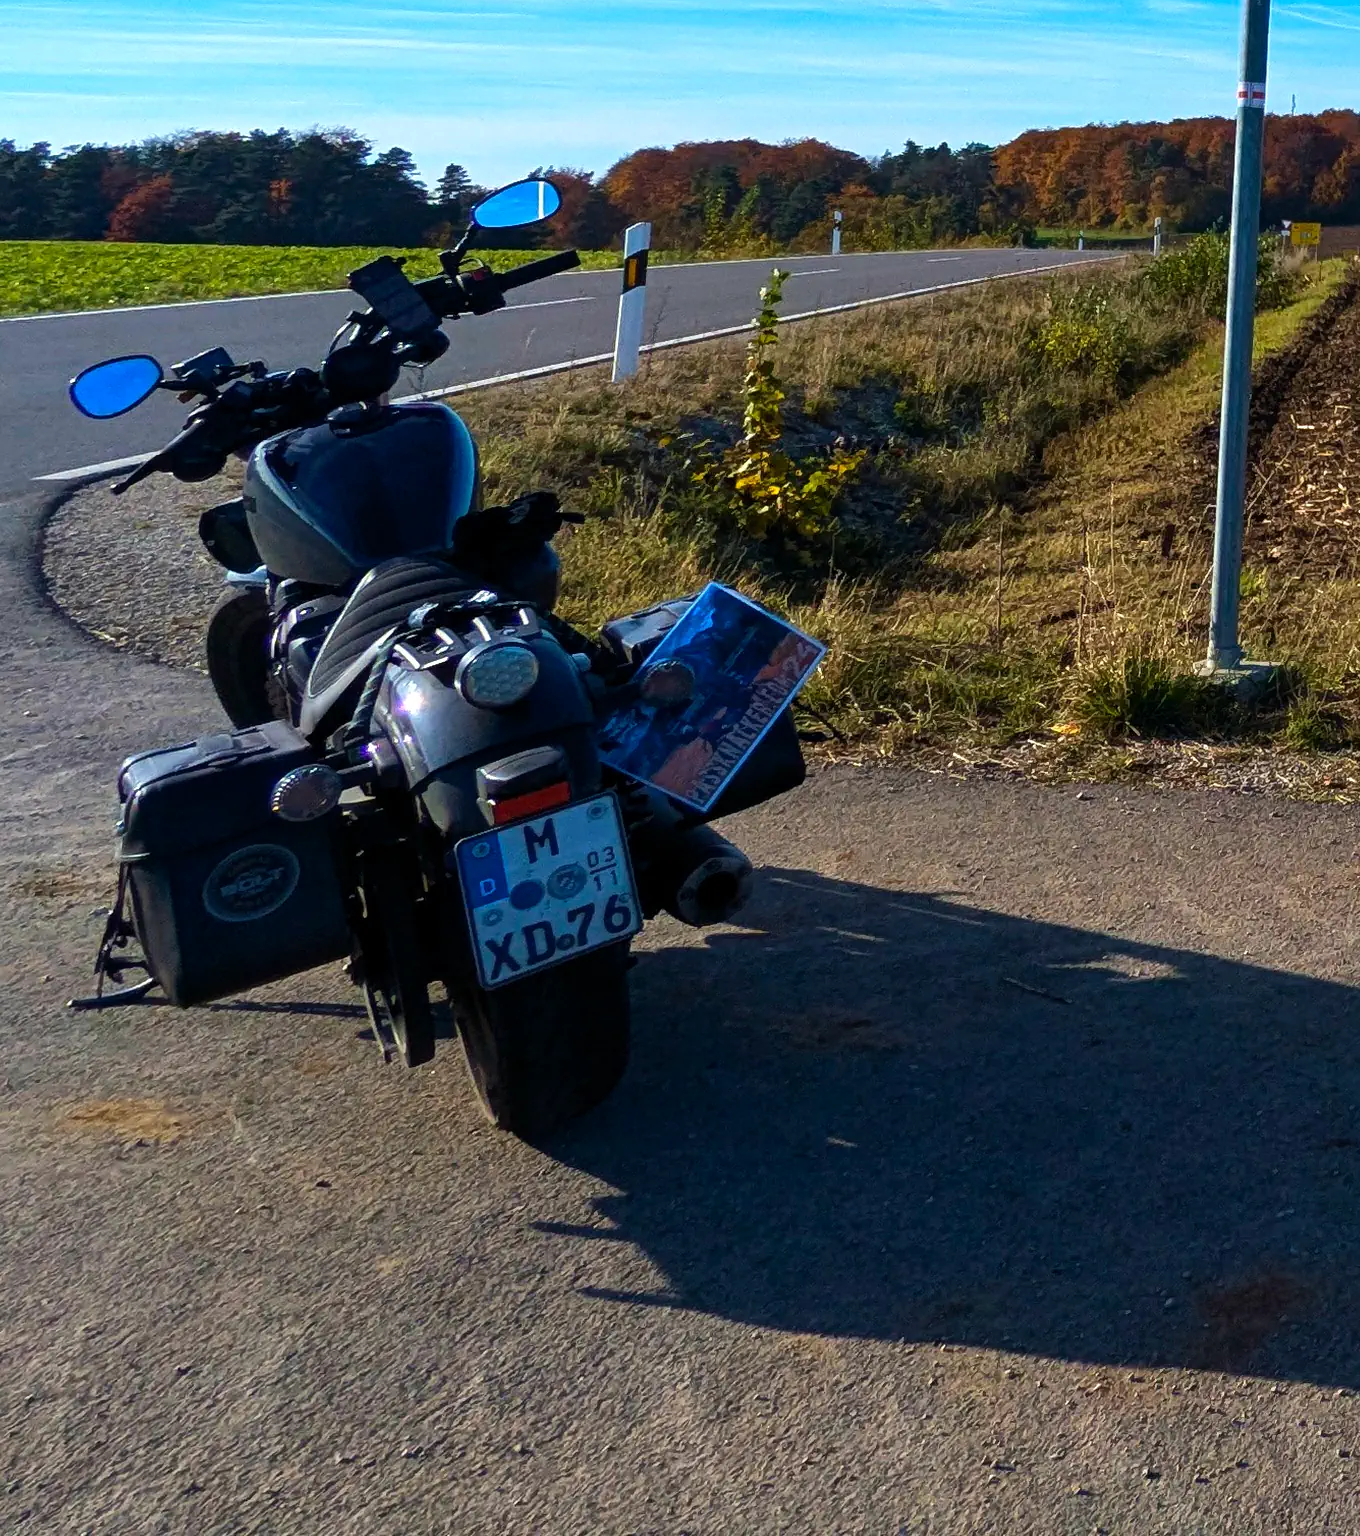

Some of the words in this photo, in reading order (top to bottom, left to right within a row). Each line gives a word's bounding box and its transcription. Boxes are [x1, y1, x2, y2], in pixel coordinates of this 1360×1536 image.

[523, 817, 560, 864] M
[586, 846, 616, 868] 03
[479, 878, 497, 897] D
[592, 869, 618, 891] 11
[484, 920, 556, 980] XD
[567, 894, 632, 946] 76
